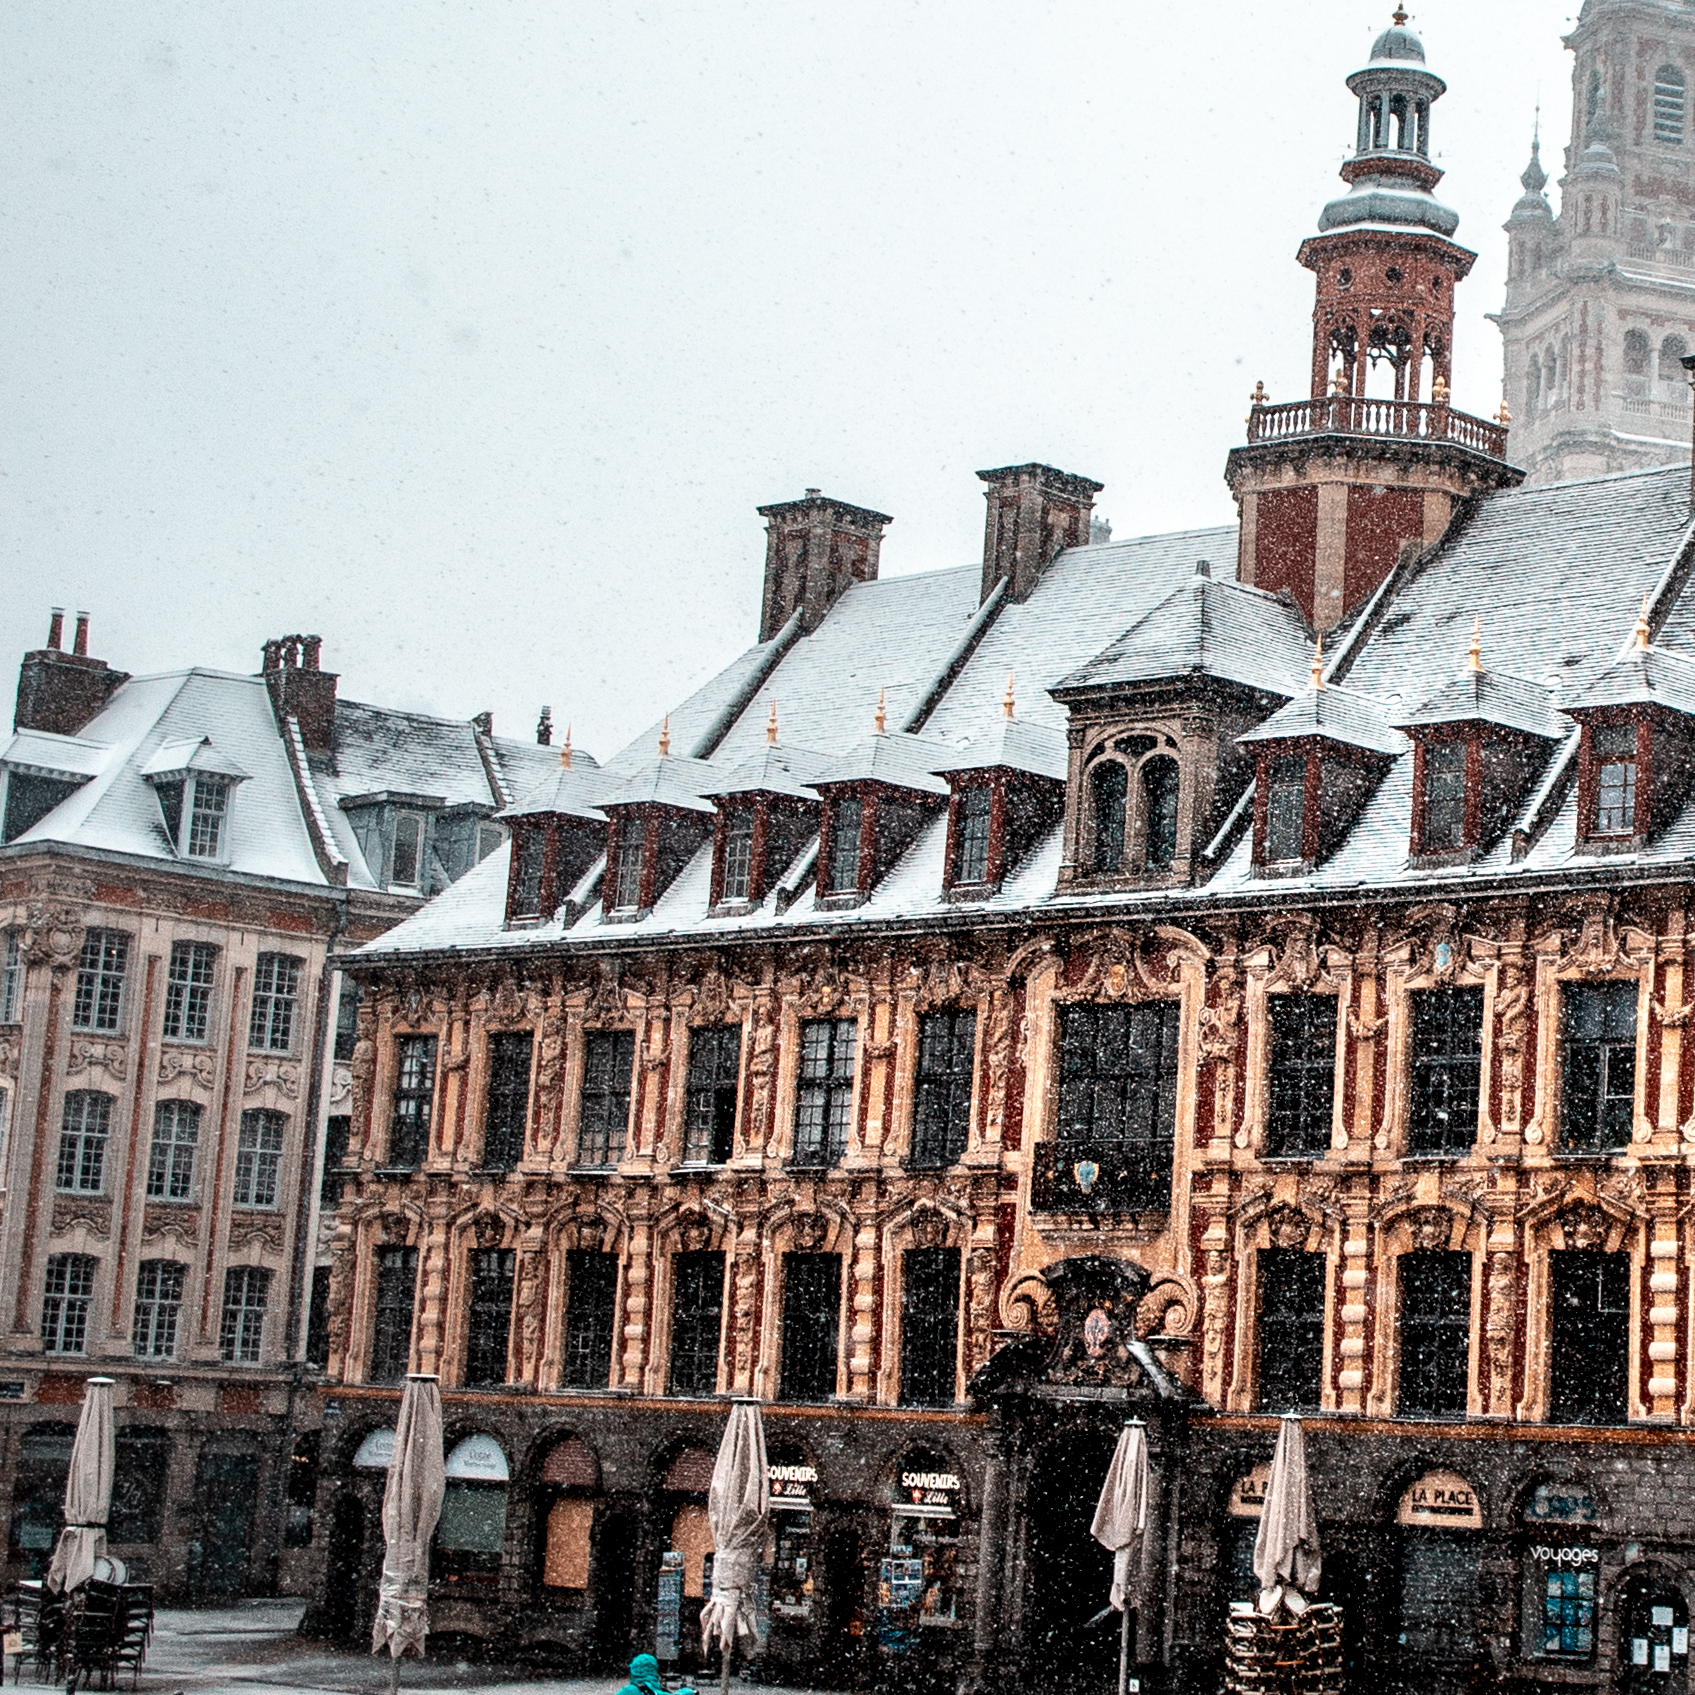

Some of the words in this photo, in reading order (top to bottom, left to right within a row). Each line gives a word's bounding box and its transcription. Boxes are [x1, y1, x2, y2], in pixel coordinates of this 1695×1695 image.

[902, 1471, 961, 1490] SOUVENIRS
[1412, 1489, 1427, 1503] LA
[1434, 1490, 1474, 1505] PLACE
[1530, 1546, 1599, 1567] voyages
